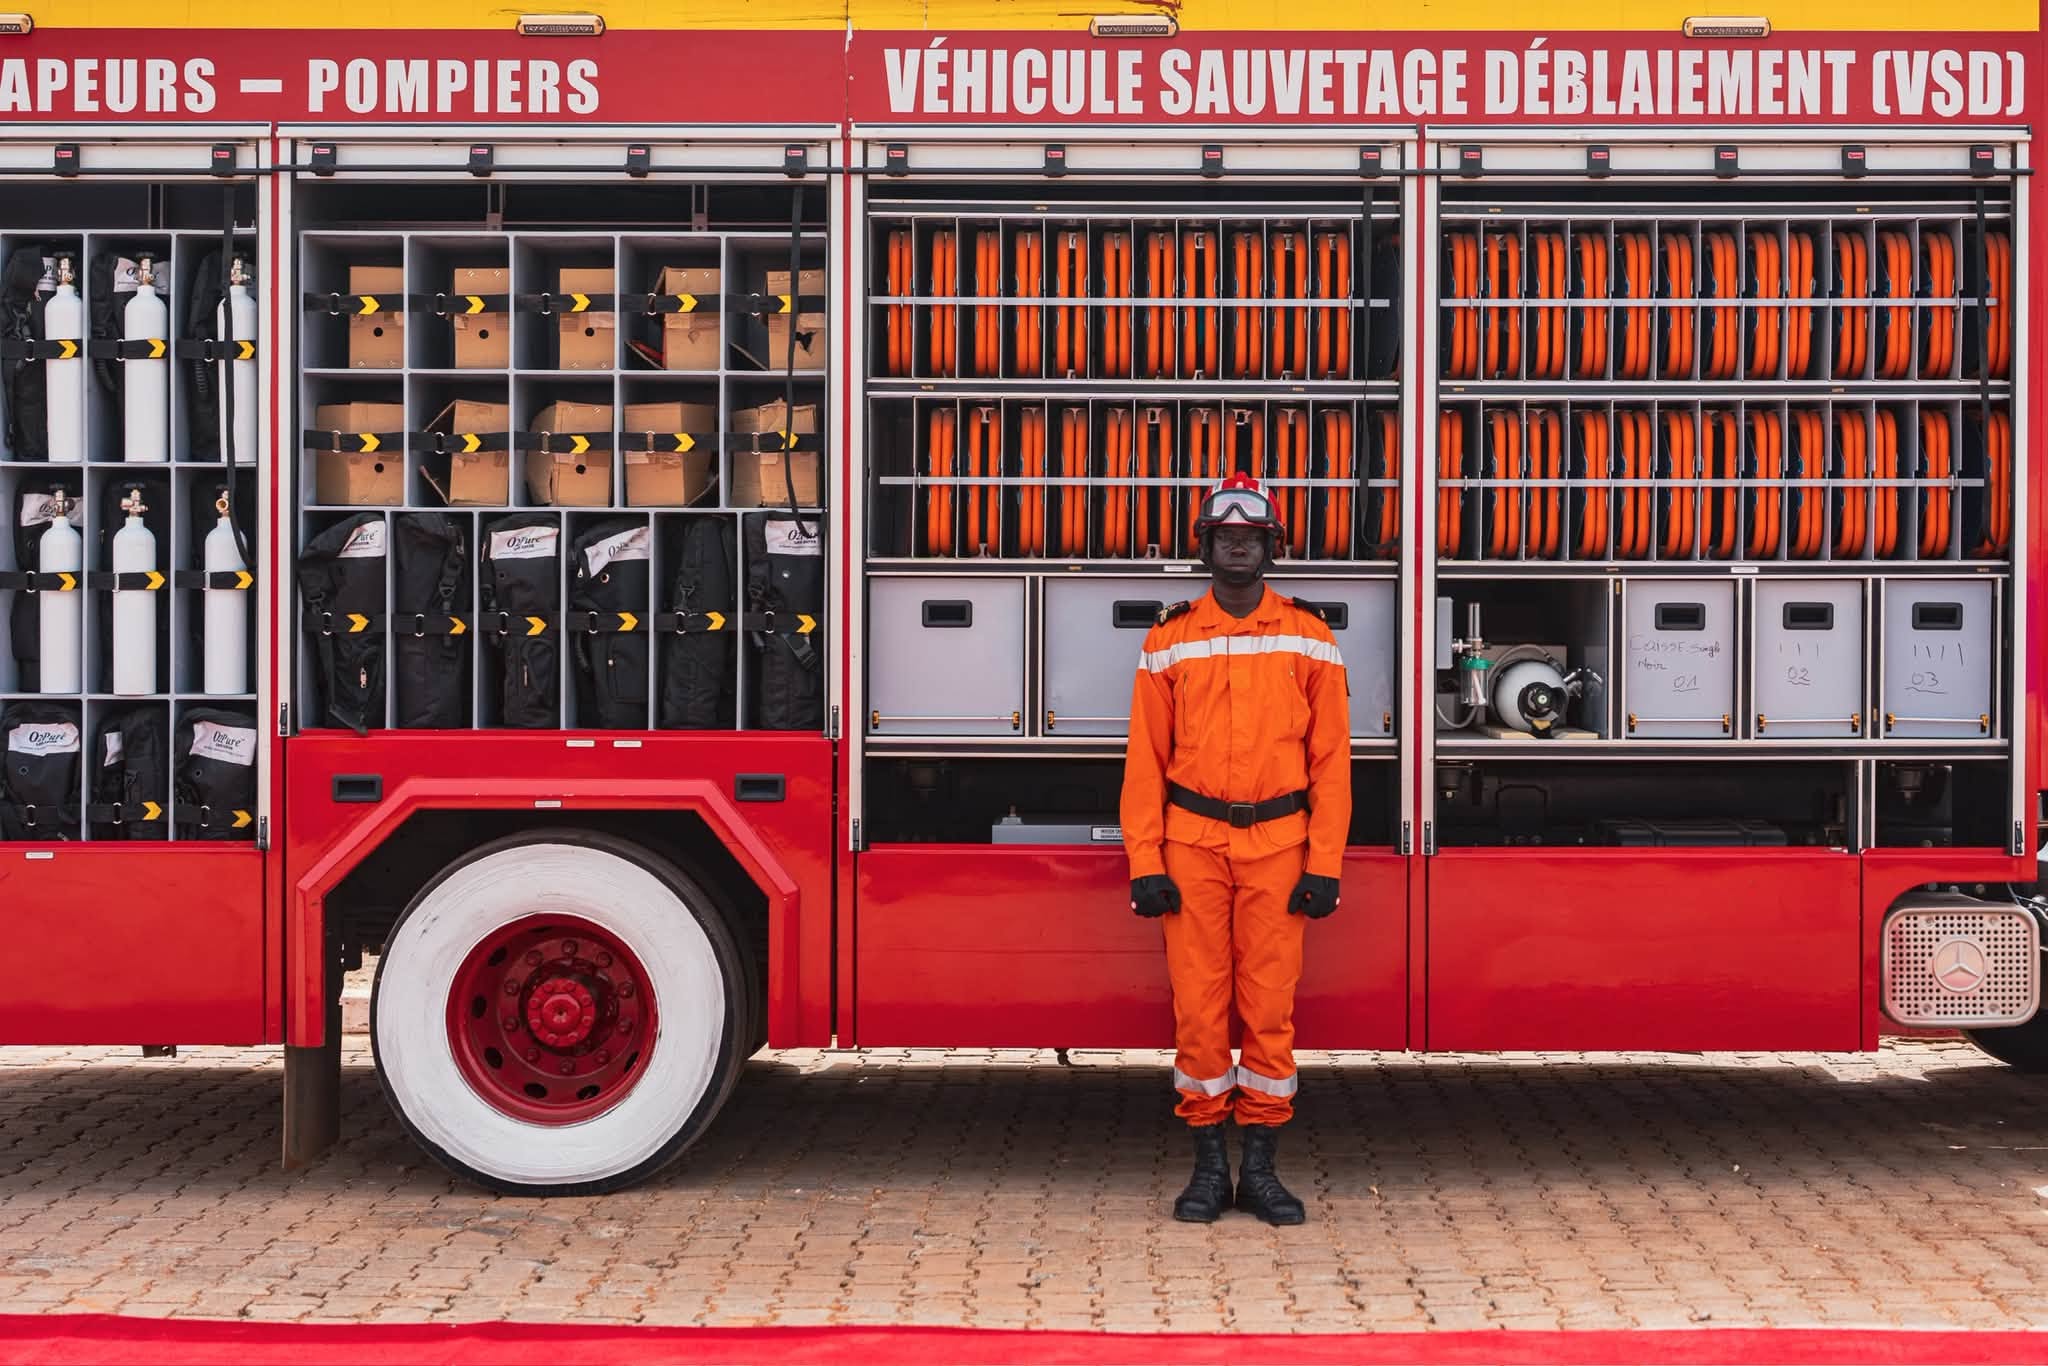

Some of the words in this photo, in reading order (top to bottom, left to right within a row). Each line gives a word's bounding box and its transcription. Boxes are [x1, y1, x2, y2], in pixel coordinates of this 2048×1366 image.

[0, 57, 216, 113] APEURS
[308, 58, 598, 114] POMPIERS
[883, 36, 1143, 115] VÉHICULE
[1159, 48, 1470, 117] SAUVETAGE
[1484, 36, 1857, 115] DÉBLAIEMENT
